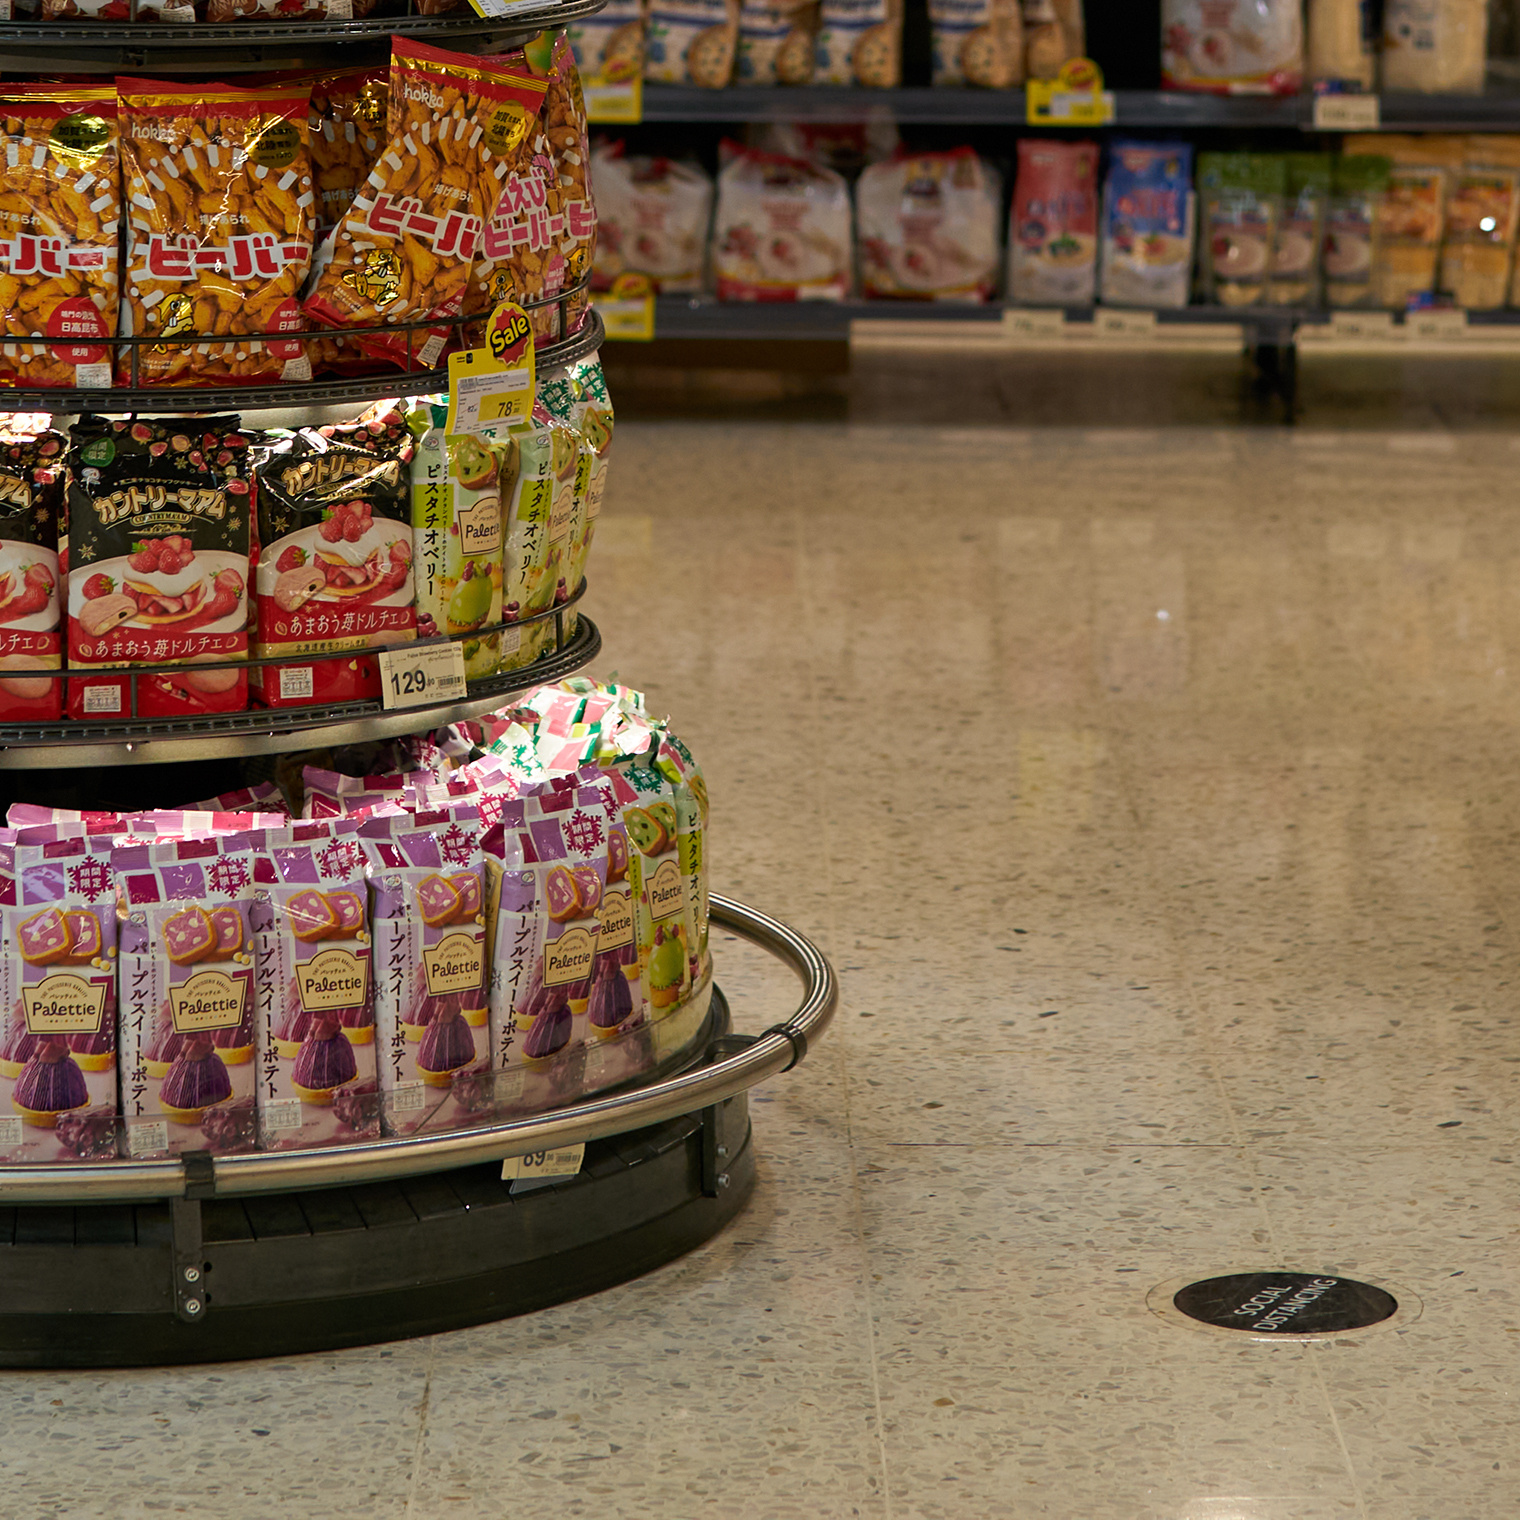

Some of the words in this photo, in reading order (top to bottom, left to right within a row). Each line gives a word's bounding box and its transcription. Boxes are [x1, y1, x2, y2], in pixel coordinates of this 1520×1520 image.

[403, 83, 445, 109] hokka
[148, 231, 310, 281] ビーバー
[490, 316, 529, 358] Sale
[93, 483, 228, 524] カントリーマアム
[422, 464, 441, 596] ピスタチオベリー
[289, 608, 401, 635] あまおう苺ドルチェ
[94, 636, 223, 660] あまおう苺ドルチェ
[304, 975, 363, 995] Palettie
[32, 999, 96, 1018] Palettie
[178, 996, 239, 1017] Palettie
[257, 918, 279, 1100] パープルスイートポテト
[129, 941, 148, 1117] パープルスイートポテト
[1233, 1285, 1293, 1318] SOCIAL
[1252, 1277, 1339, 1332] DISTANCING
